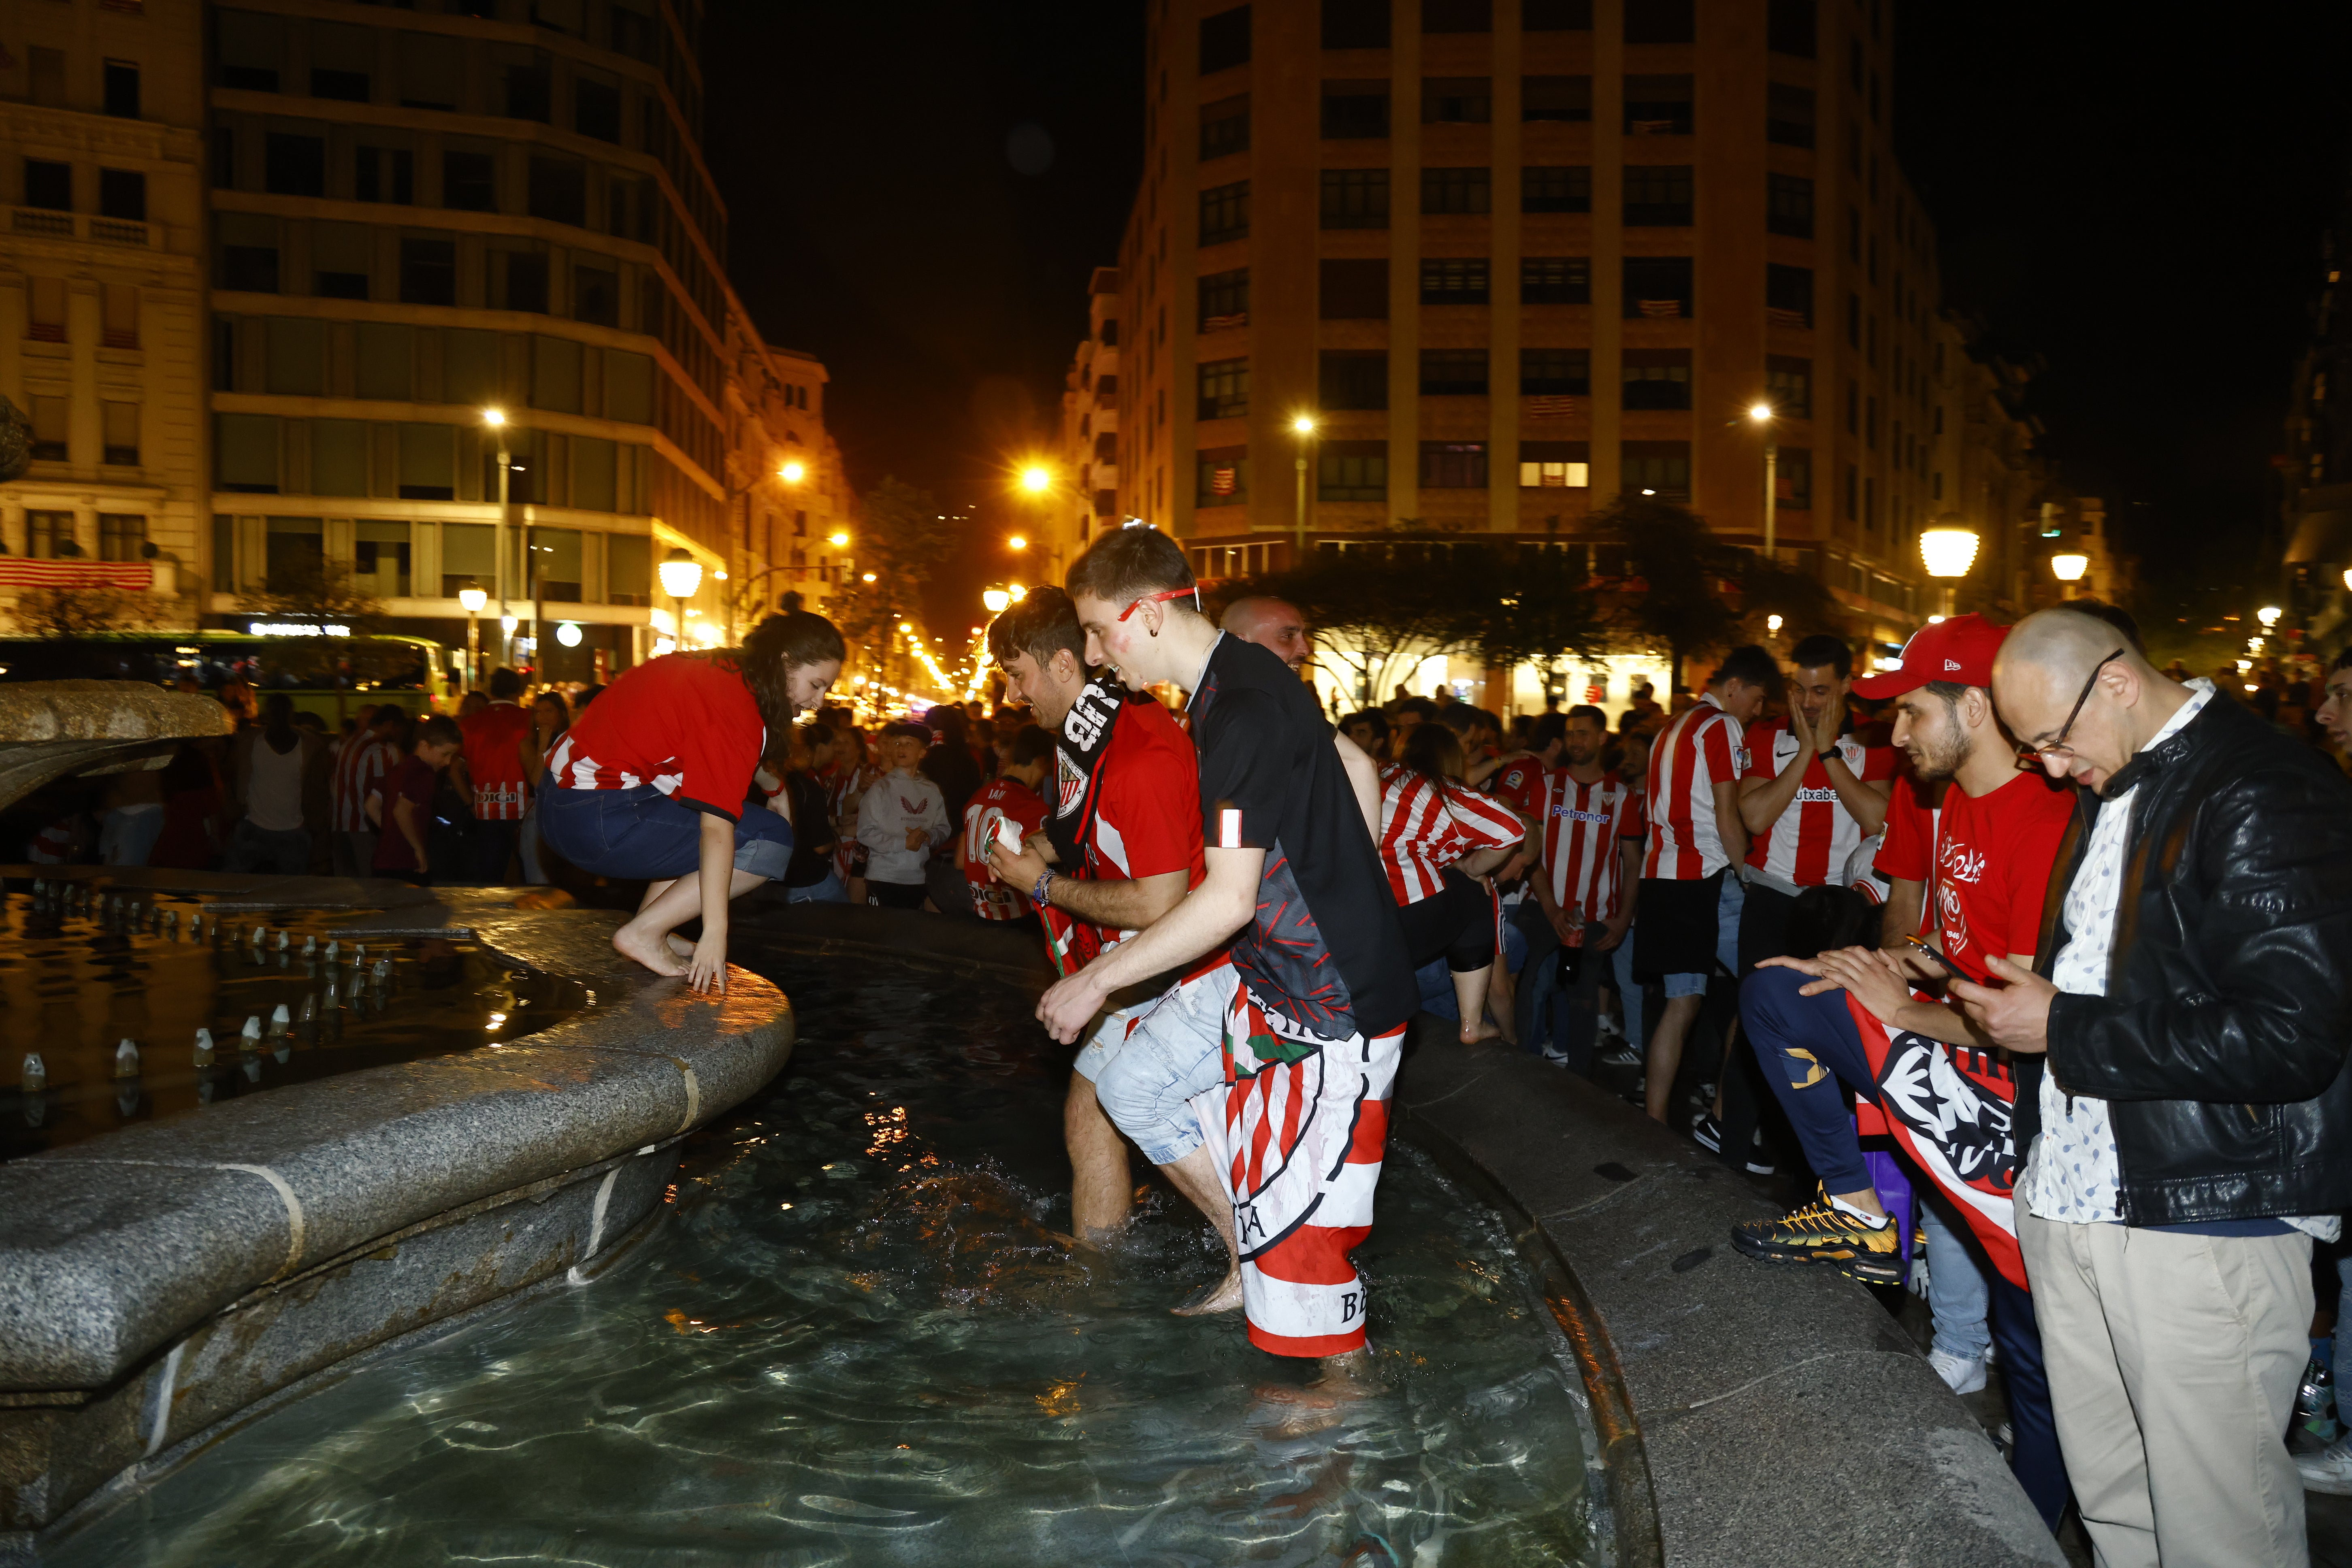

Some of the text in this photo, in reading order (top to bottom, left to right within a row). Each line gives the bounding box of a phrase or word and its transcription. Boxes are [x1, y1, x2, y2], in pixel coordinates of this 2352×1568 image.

[1074, 768, 1085, 781] CLUB
[1796, 788, 1839, 800] utxaba
[1553, 805, 1610, 824] Petronor
[965, 803, 1003, 865] 10
[1946, 930, 1960, 940] 1946
